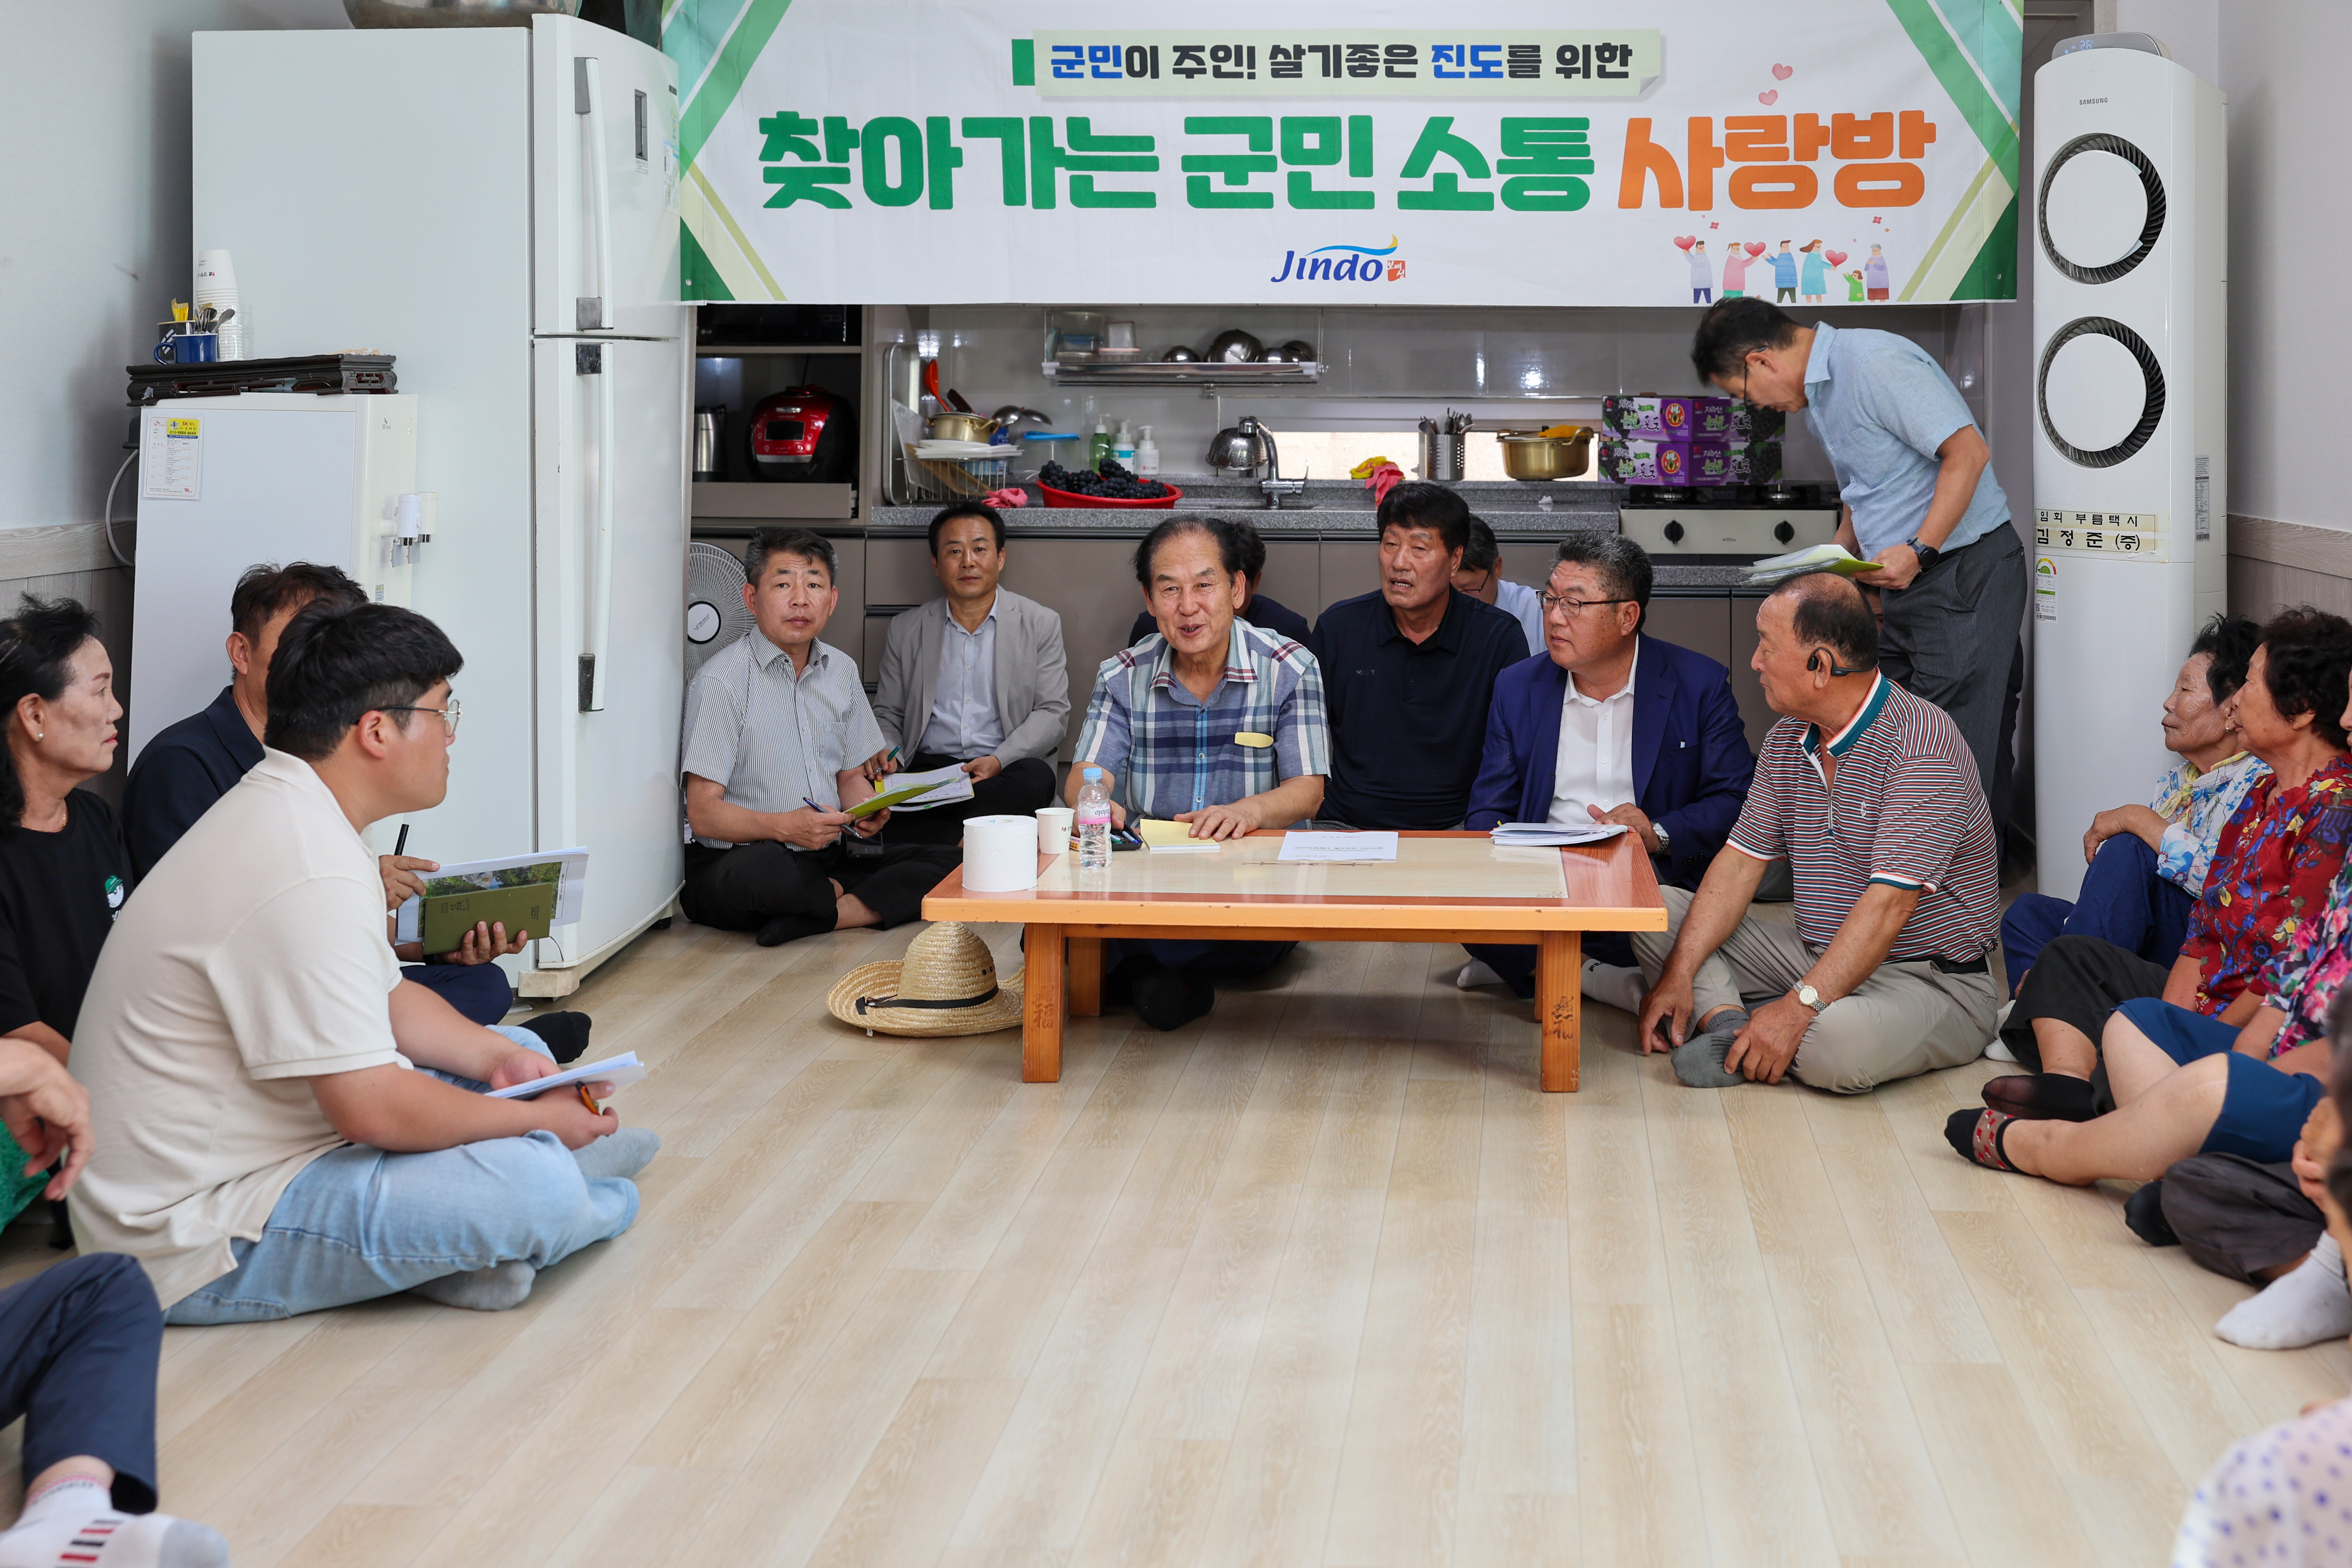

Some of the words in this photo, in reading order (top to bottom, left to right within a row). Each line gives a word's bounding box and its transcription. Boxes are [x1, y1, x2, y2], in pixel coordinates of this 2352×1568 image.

[1051, 45, 1160, 80] 군민이
[1172, 45, 1256, 80] 주인!
[1269, 44, 1418, 79] 살기좋은
[1431, 44, 1542, 79] 진도를
[1555, 43, 1633, 80] 위한
[759, 111, 1160, 211] 찾아가는
[1181, 115, 1375, 210] 군민
[1397, 116, 1594, 211] 소통
[1618, 110, 1936, 211] 사랑방
[1270, 250, 1383, 283] Jindo
[2040, 511, 2062, 523] 임회
[2076, 514, 2138, 527] 부름택시
[2037, 528, 2103, 548] 김정준
[2115, 534, 2140, 551] (증)
